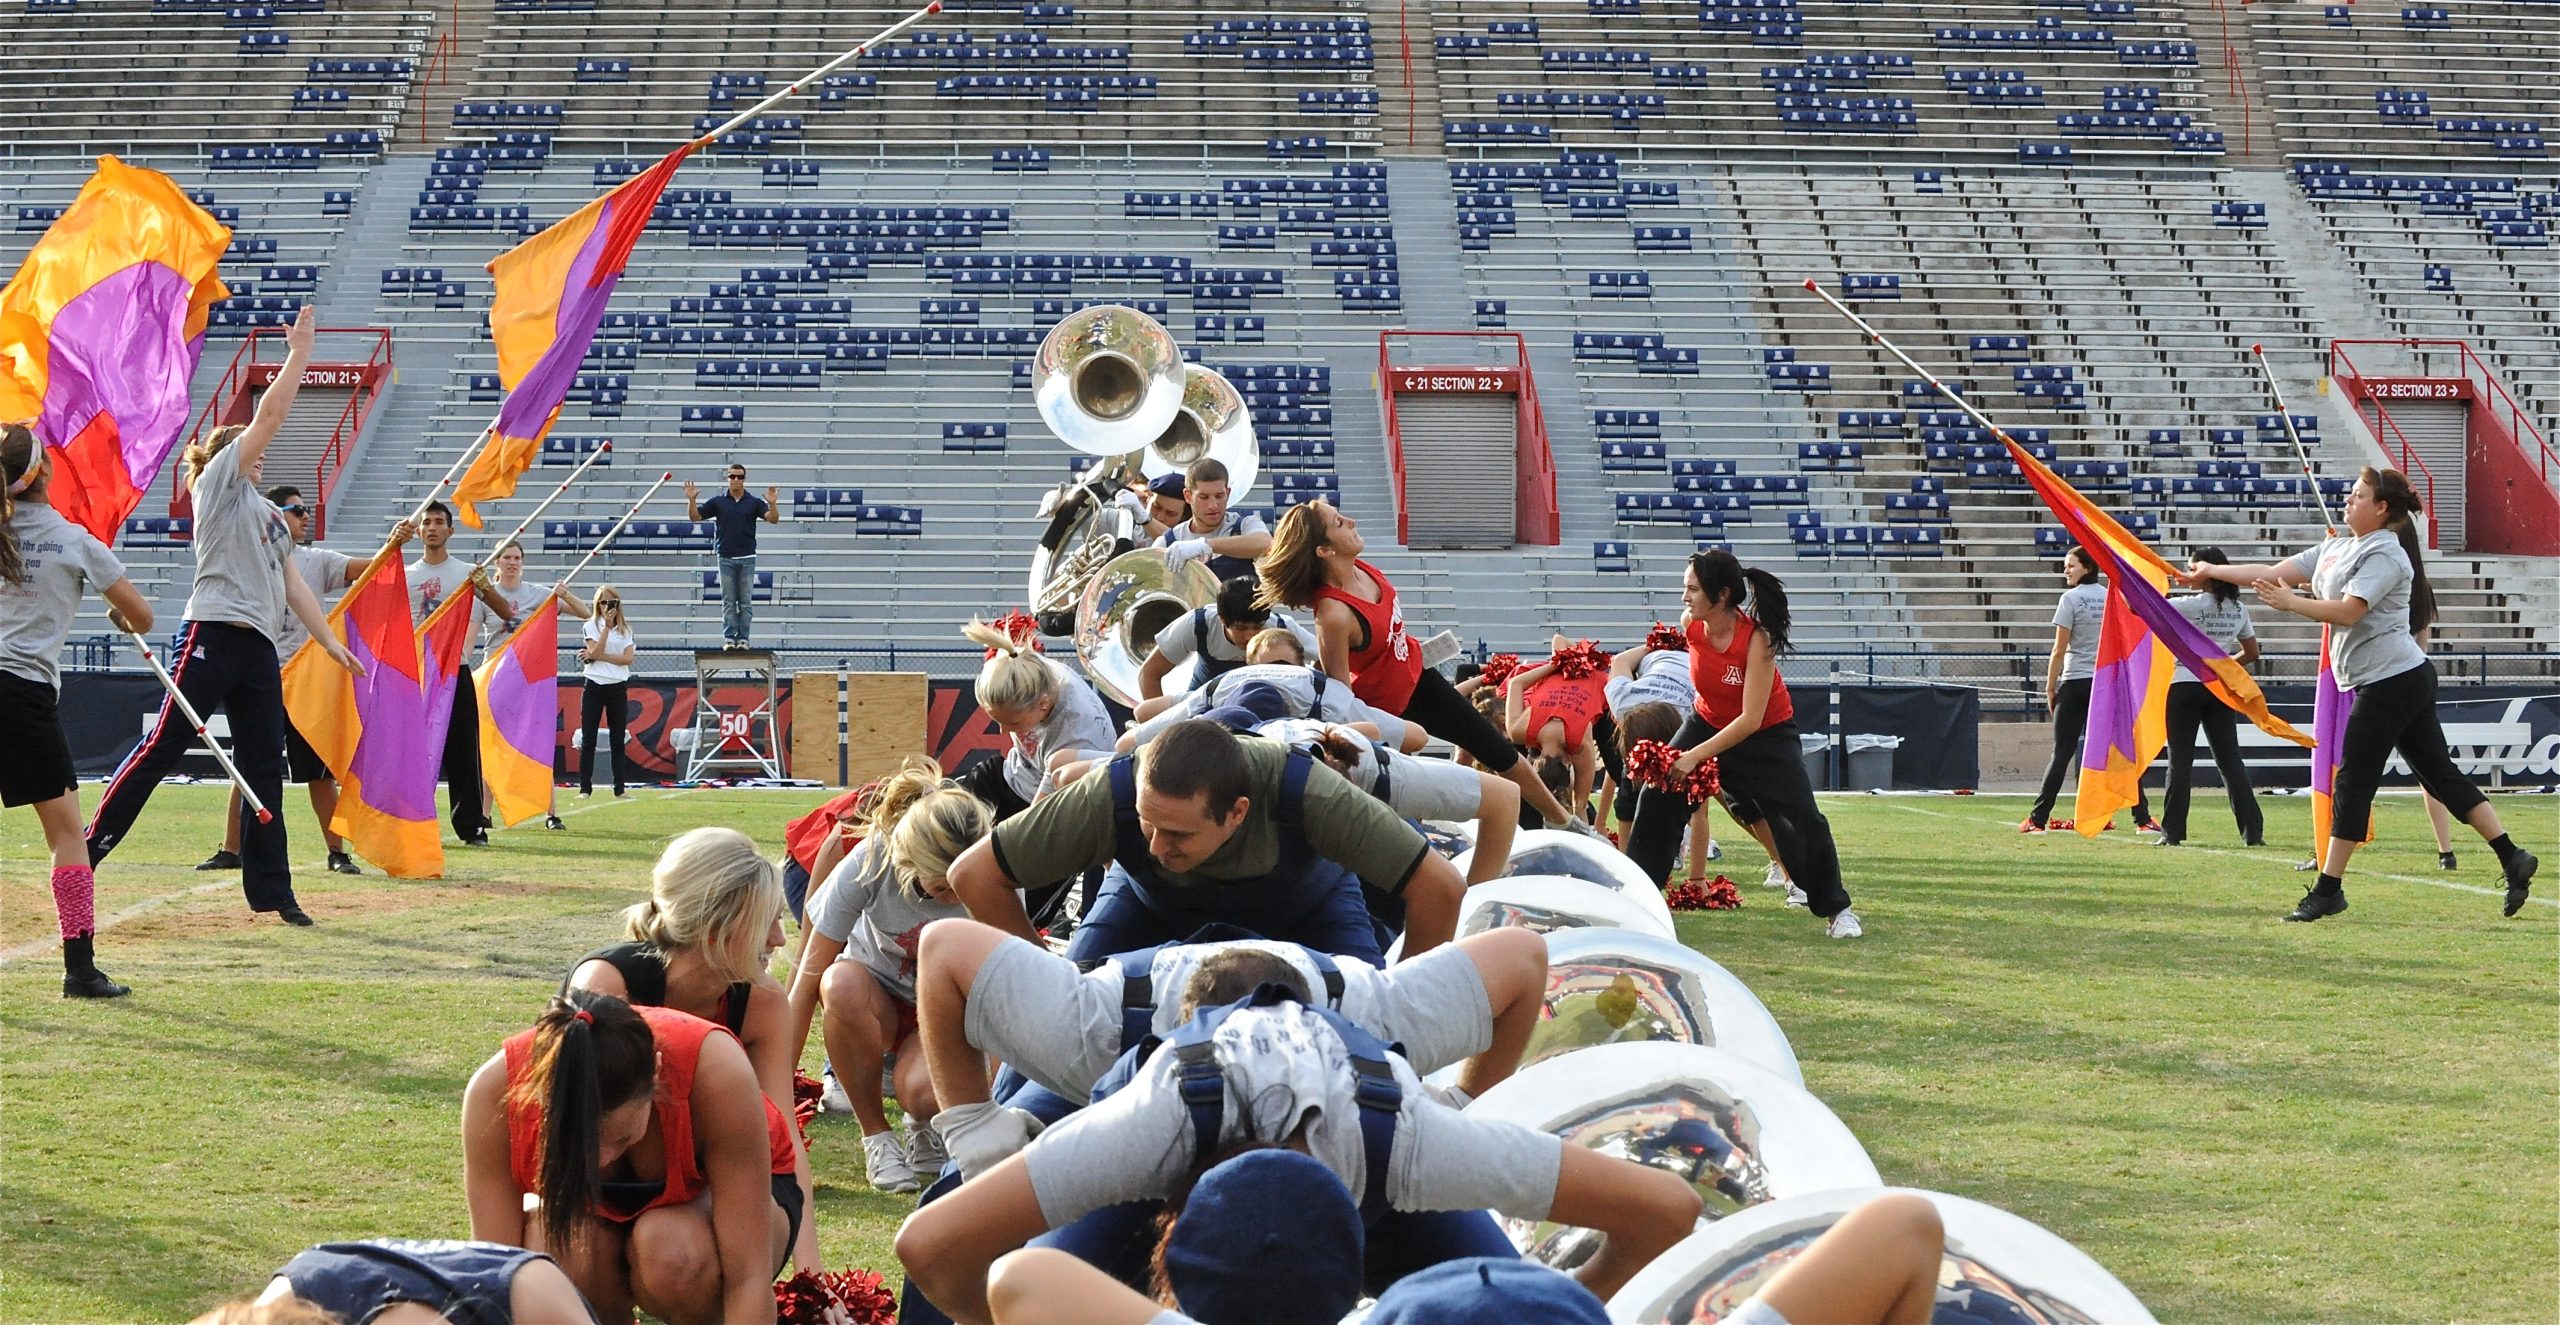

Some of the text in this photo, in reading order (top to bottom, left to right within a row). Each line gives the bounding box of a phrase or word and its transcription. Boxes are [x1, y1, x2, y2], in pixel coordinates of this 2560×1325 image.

[300, 371, 350, 384] ECTION 21
[1417, 377, 1491, 390] 21 SECTION 22
[2376, 384, 2447, 397] 22 SECTION 23
[1722, 664, 1745, 685] A
[721, 713, 748, 736] 50
